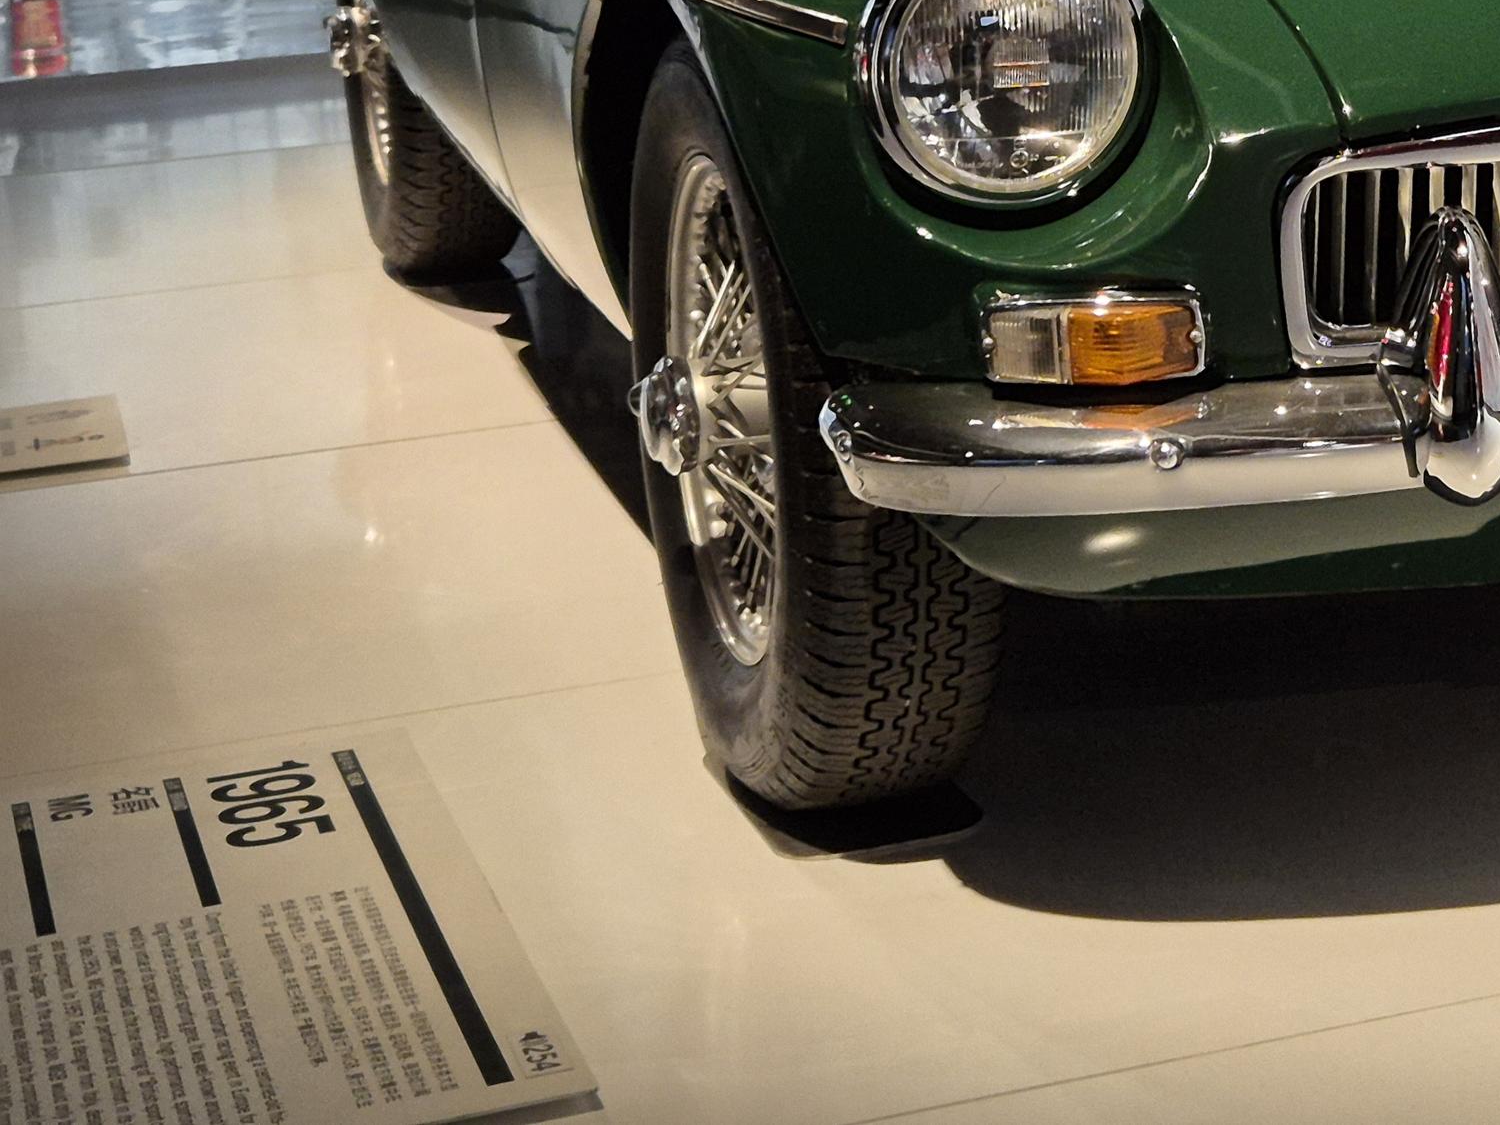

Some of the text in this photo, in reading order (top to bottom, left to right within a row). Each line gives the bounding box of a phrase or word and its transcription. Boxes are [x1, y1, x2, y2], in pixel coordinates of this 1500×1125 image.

[48, 793, 94, 822] MG
[206, 760, 336, 847] 1965
[522, 1043, 562, 1072] 254
